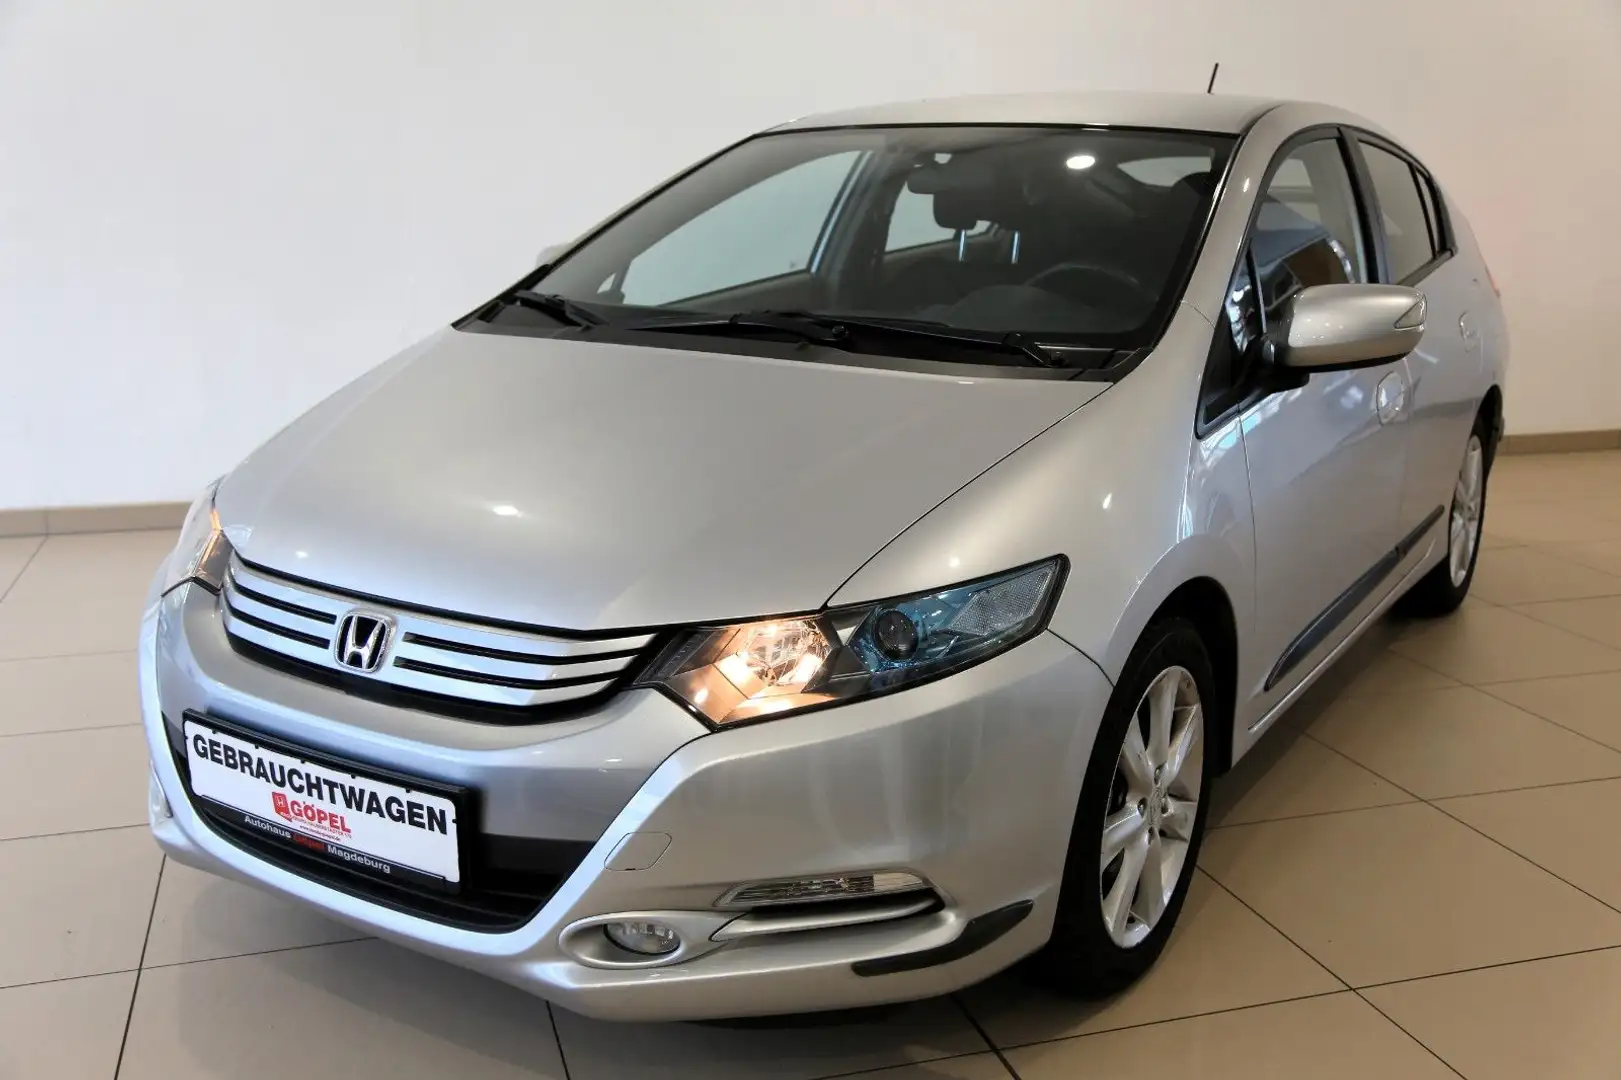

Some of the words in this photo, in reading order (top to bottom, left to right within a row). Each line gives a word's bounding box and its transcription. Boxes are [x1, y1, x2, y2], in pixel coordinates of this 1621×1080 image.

[193, 734, 448, 835] GEBRAUCHTWAGEN
[244, 815, 292, 839] Autohaus
[327, 844, 391, 874] Magdeburg
[290, 800, 352, 833] GÖPEL
